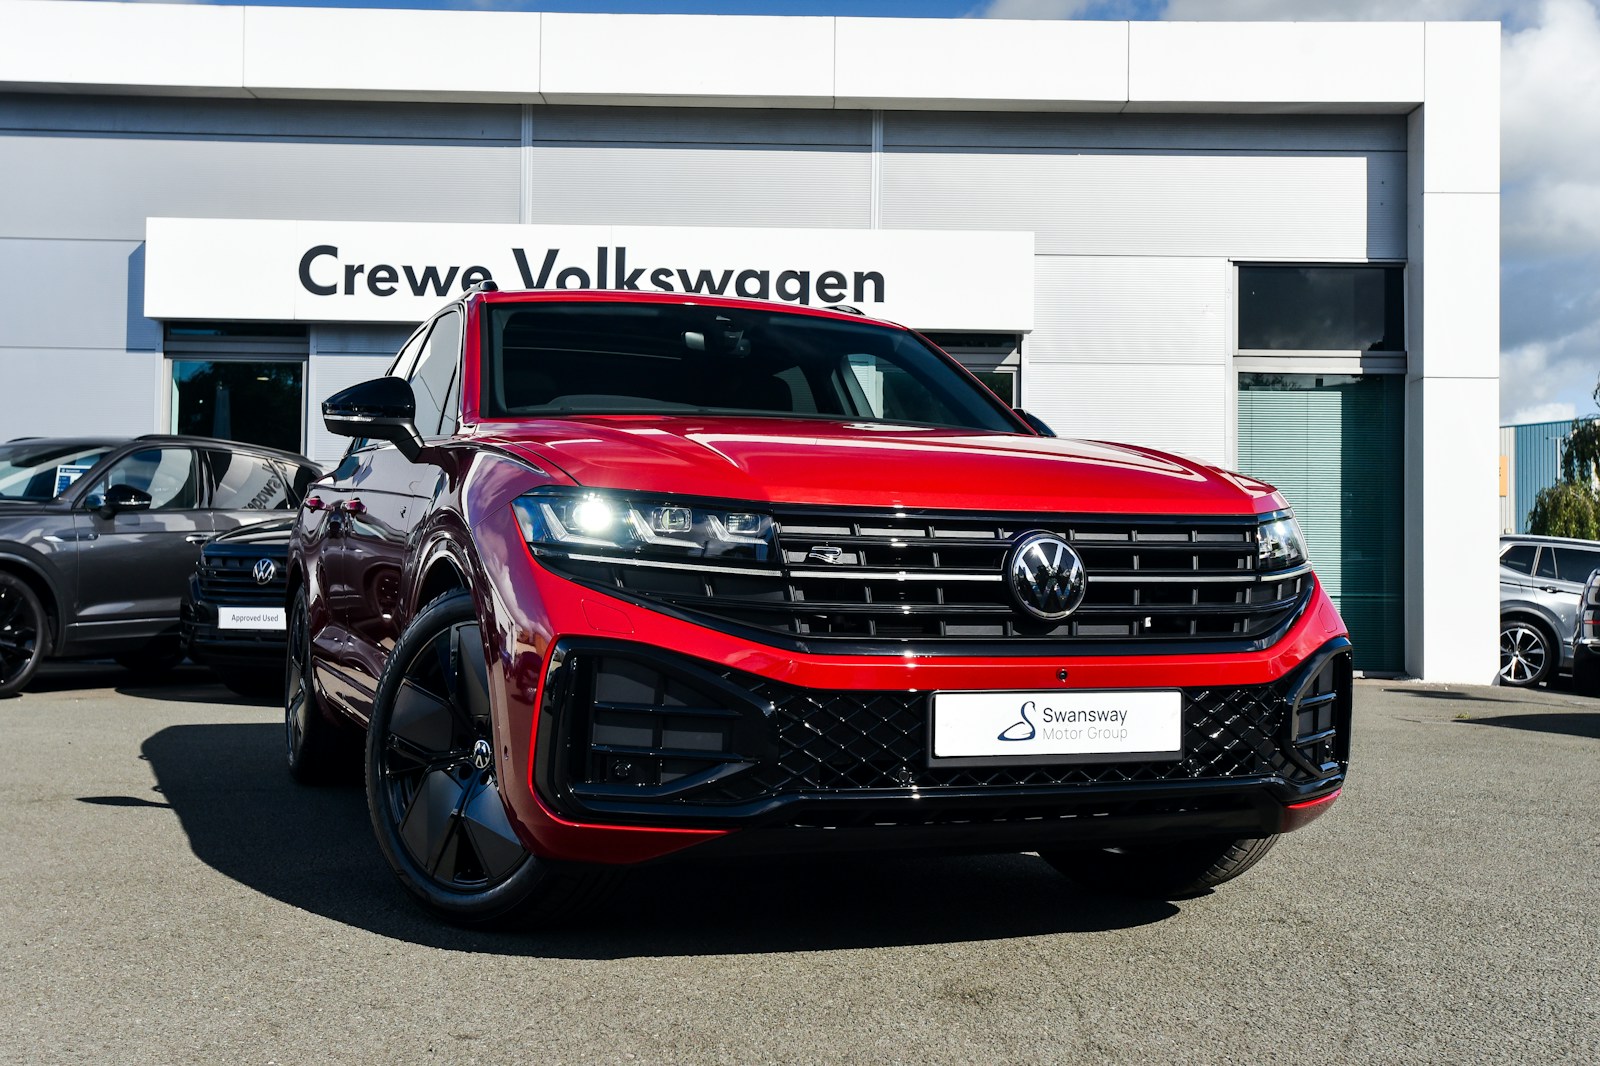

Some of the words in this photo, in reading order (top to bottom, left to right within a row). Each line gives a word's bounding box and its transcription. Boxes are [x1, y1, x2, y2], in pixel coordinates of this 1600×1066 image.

[298, 244, 492, 297] Crewe
[511, 246, 886, 305] Volkswagen
[231, 614, 261, 623] Approved
[263, 614, 279, 622] Used
[1043, 707, 1128, 726] Swansway
[1042, 727, 1083, 740] Motor
[1087, 726, 1128, 741] Group
